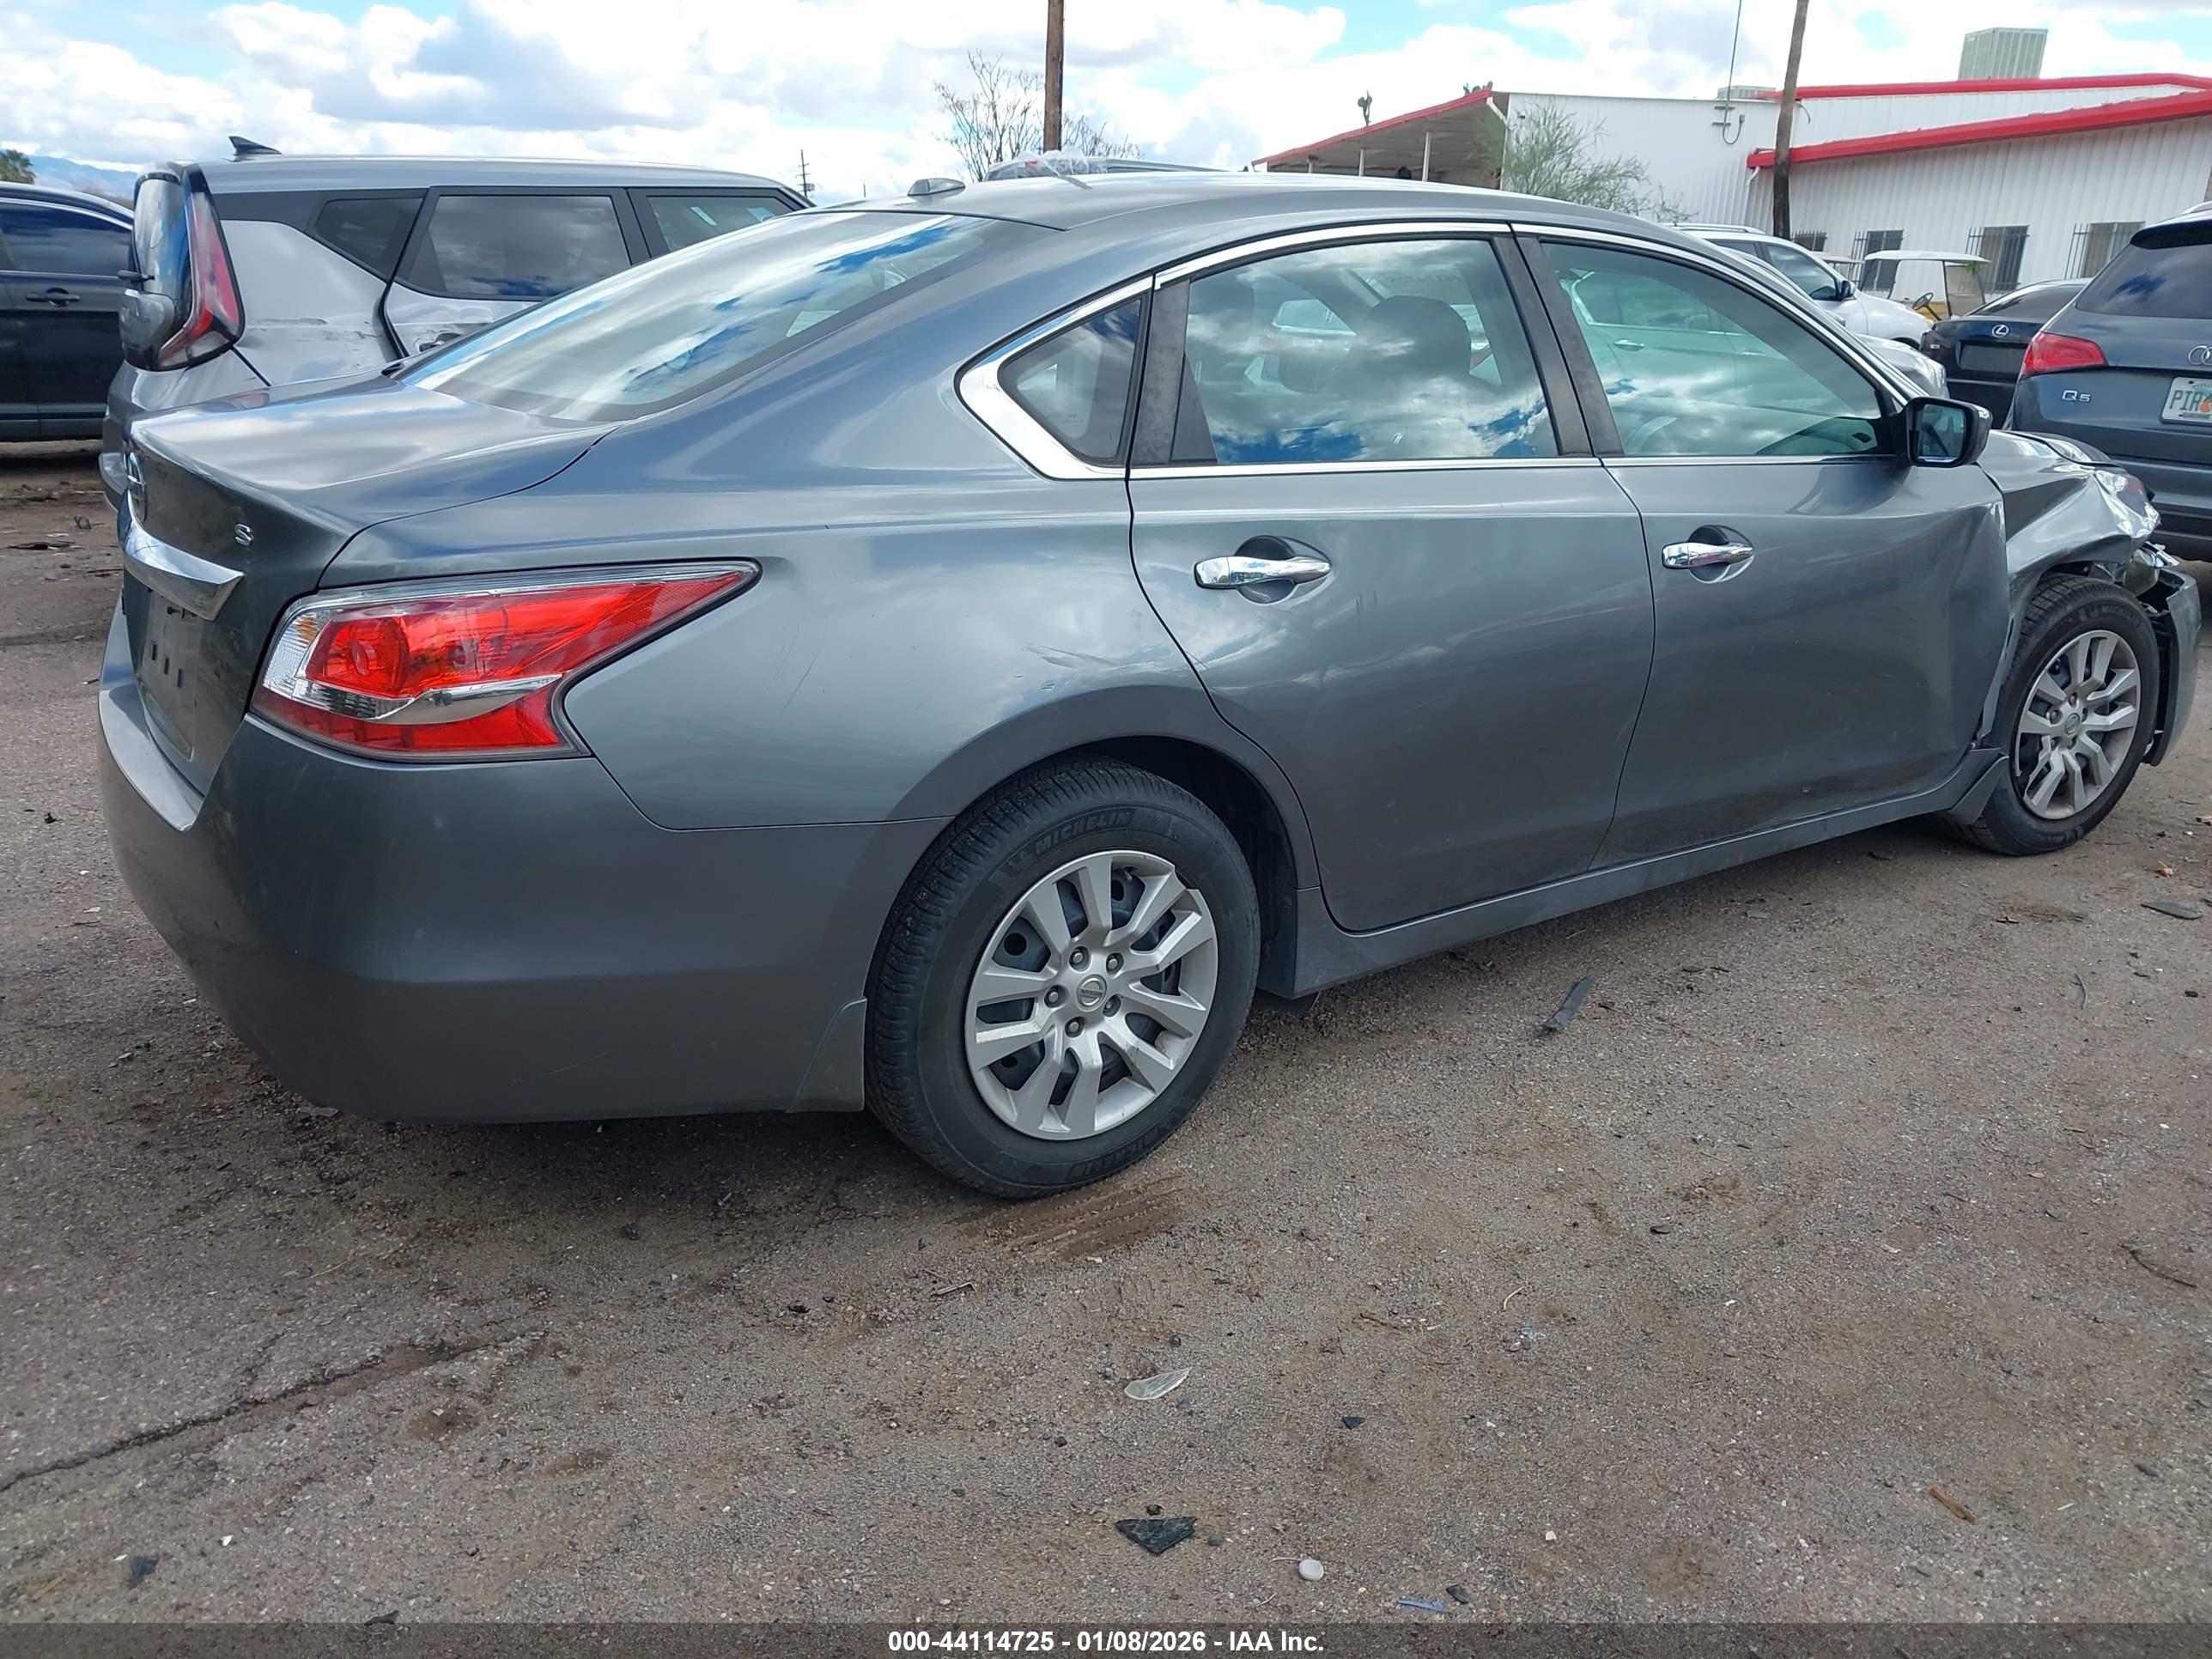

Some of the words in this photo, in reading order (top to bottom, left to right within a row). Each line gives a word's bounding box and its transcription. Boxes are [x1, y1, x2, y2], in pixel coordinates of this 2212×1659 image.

[2062, 390, 2091, 402] Q5
[234, 524, 253, 545] S
[1036, 812, 1130, 854] MICHELIN
